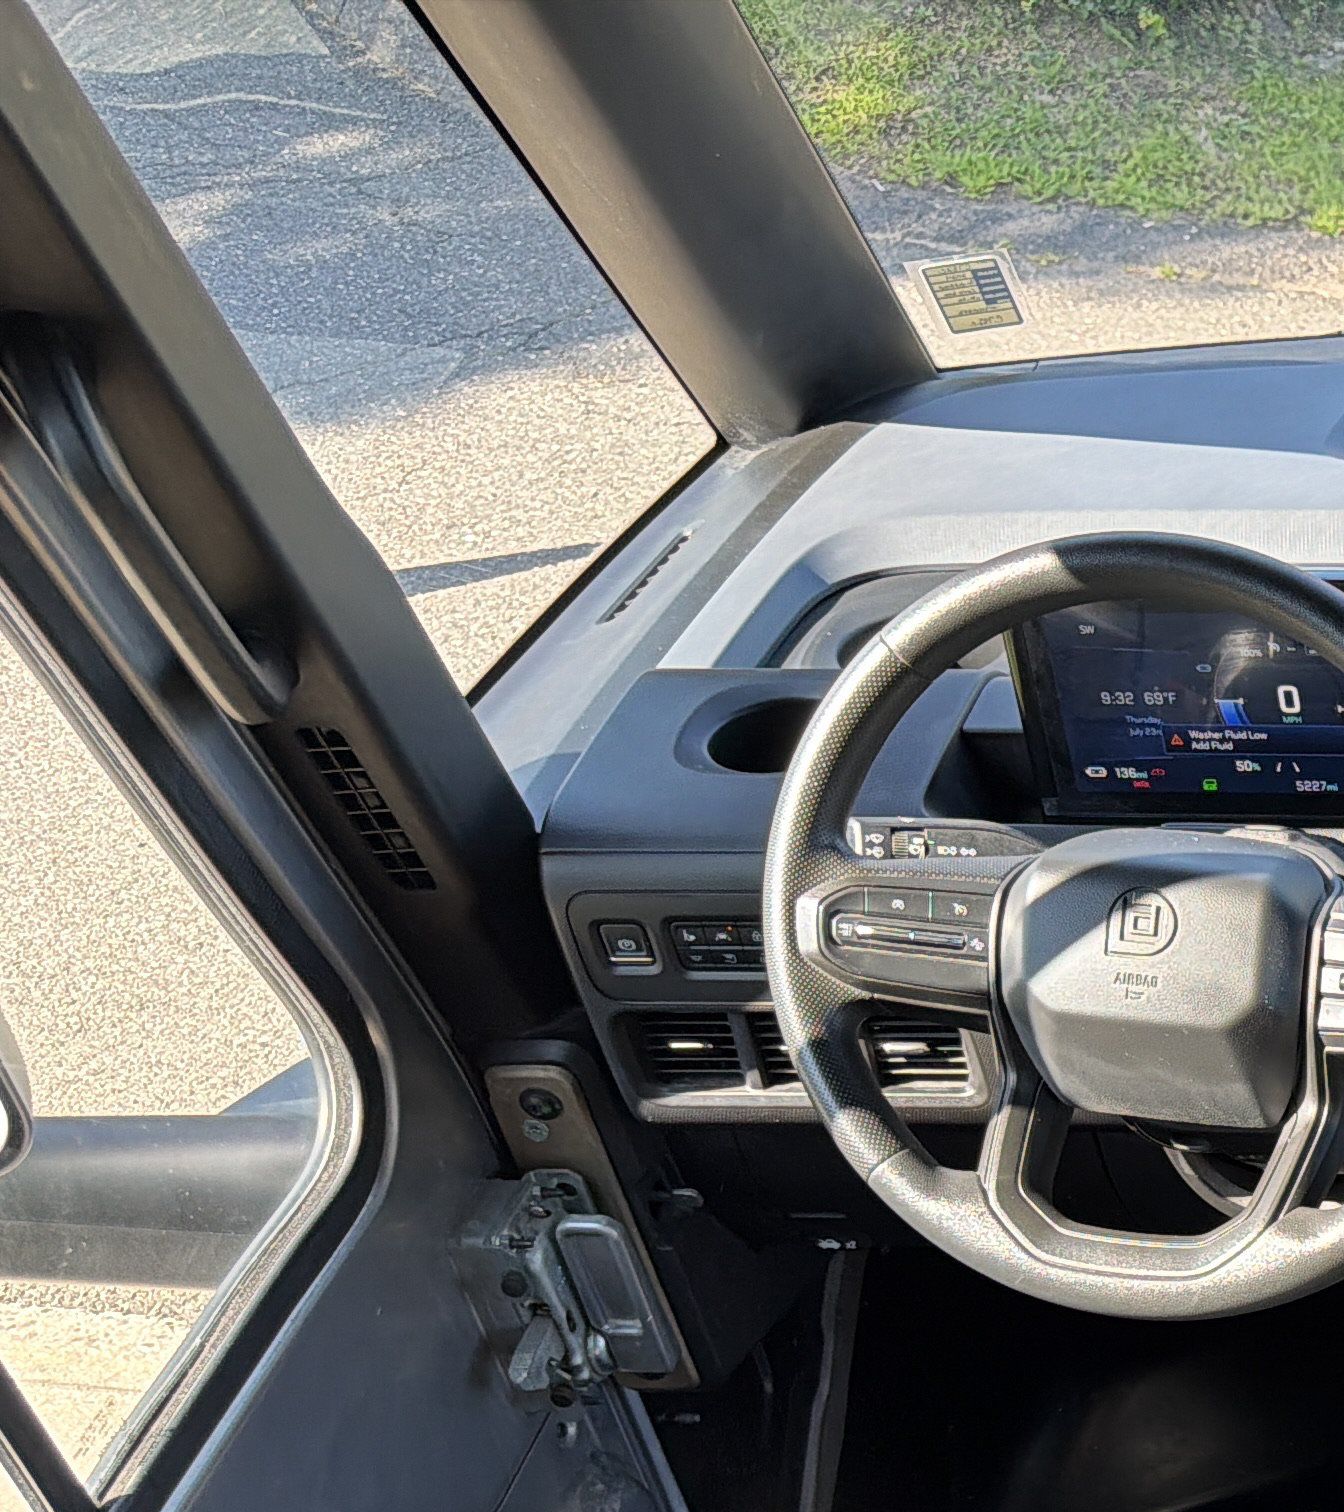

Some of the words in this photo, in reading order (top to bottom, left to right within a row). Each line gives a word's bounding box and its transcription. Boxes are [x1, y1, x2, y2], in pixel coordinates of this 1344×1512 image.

[1079, 625, 1095, 635] SW
[1100, 691, 1135, 705] 9:32
[1143, 691, 1177, 705] 69°F
[1277, 685, 1301, 713] 0
[1282, 715, 1302, 724] MPH
[1129, 727, 1143, 737] July
[1188, 730, 1223, 740] Washer
[1224, 730, 1247, 740] Fluid
[1248, 730, 1268, 740] Low
[1191, 741, 1210, 750] Add
[1211, 741, 1234, 750] Fluid
[1235, 760, 1261, 771] 50%
[1113, 972, 1158, 988] AIRBAG
